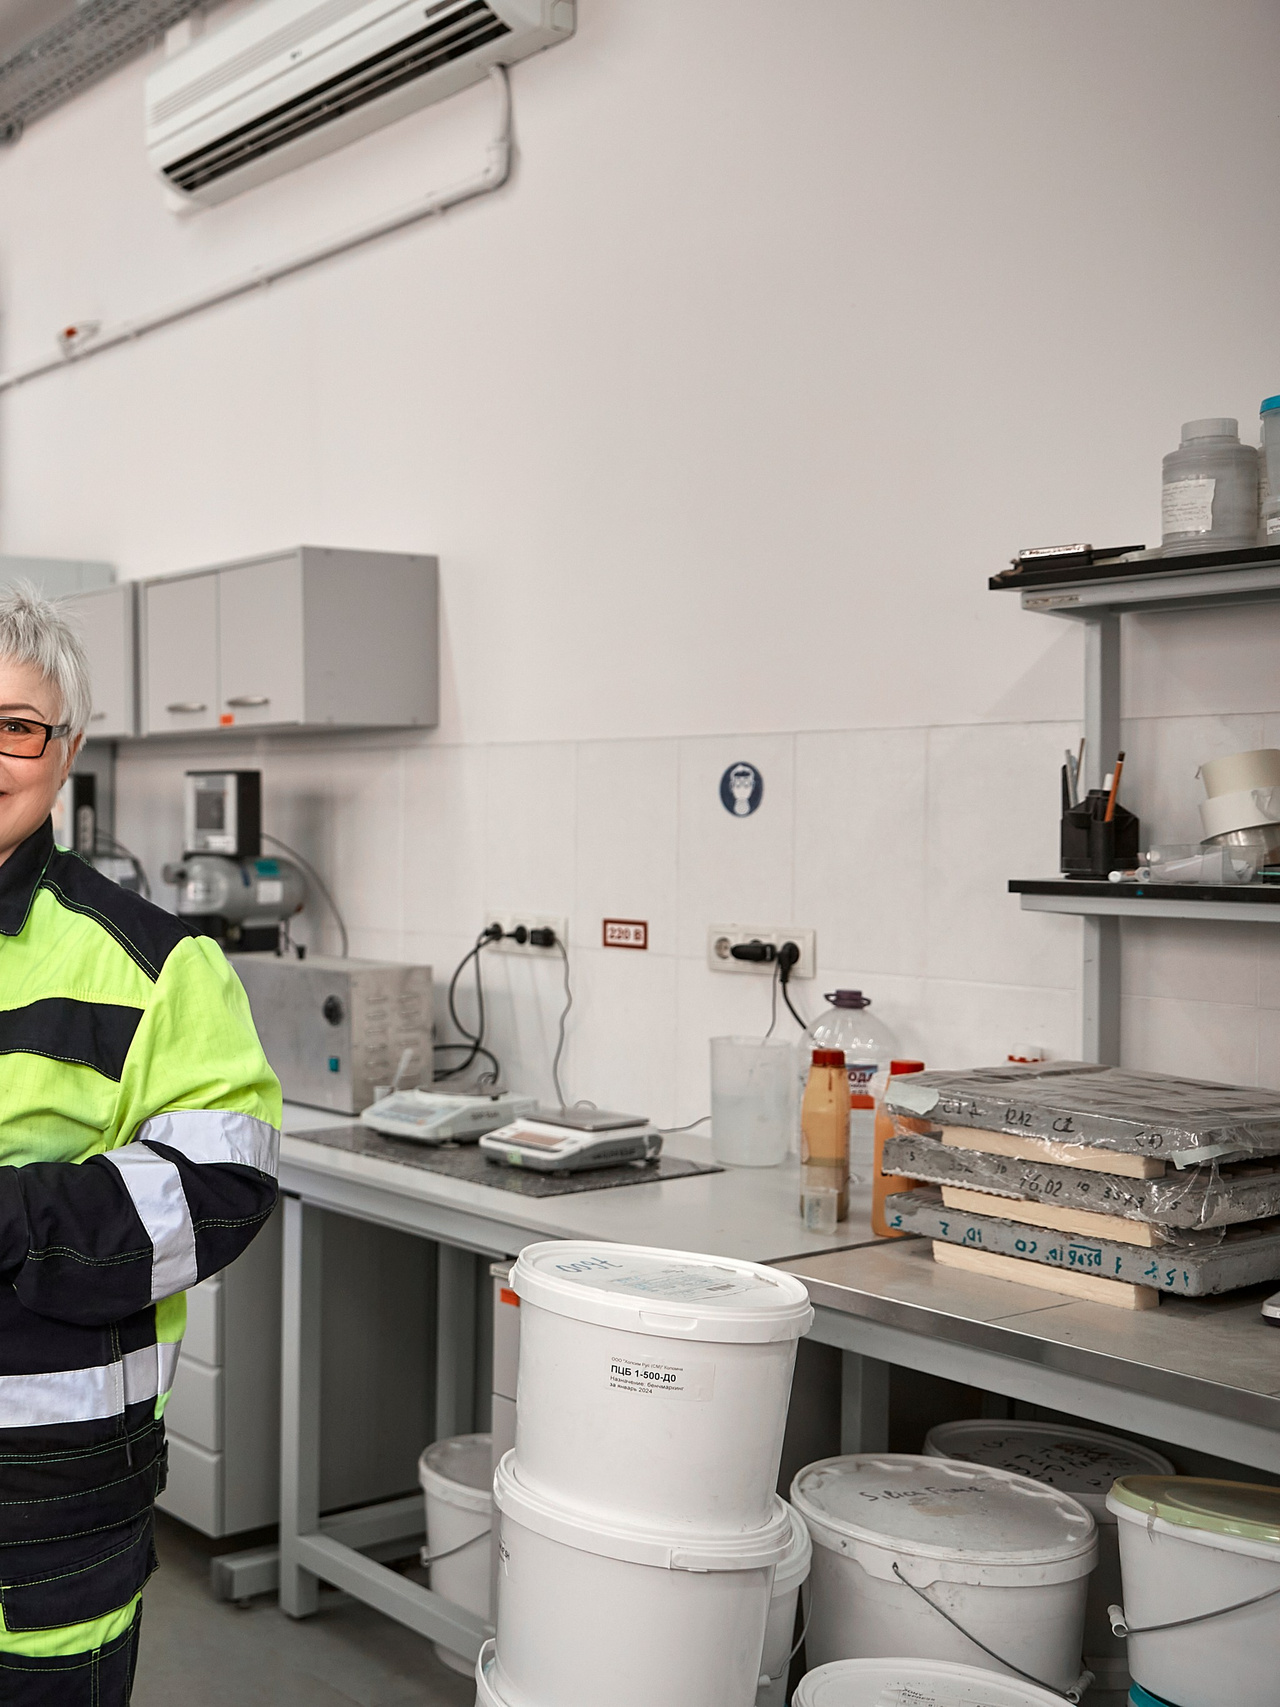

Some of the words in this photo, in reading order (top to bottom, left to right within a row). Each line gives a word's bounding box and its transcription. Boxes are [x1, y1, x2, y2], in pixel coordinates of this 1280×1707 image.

[609, 926, 631, 941] 220
[610, 1364, 632, 1377] ПЦБ
[634, 1369, 677, 1384] 1-500-Д0
[617, 1384, 637, 1392] январь
[638, 1386, 653, 1394] 2024
